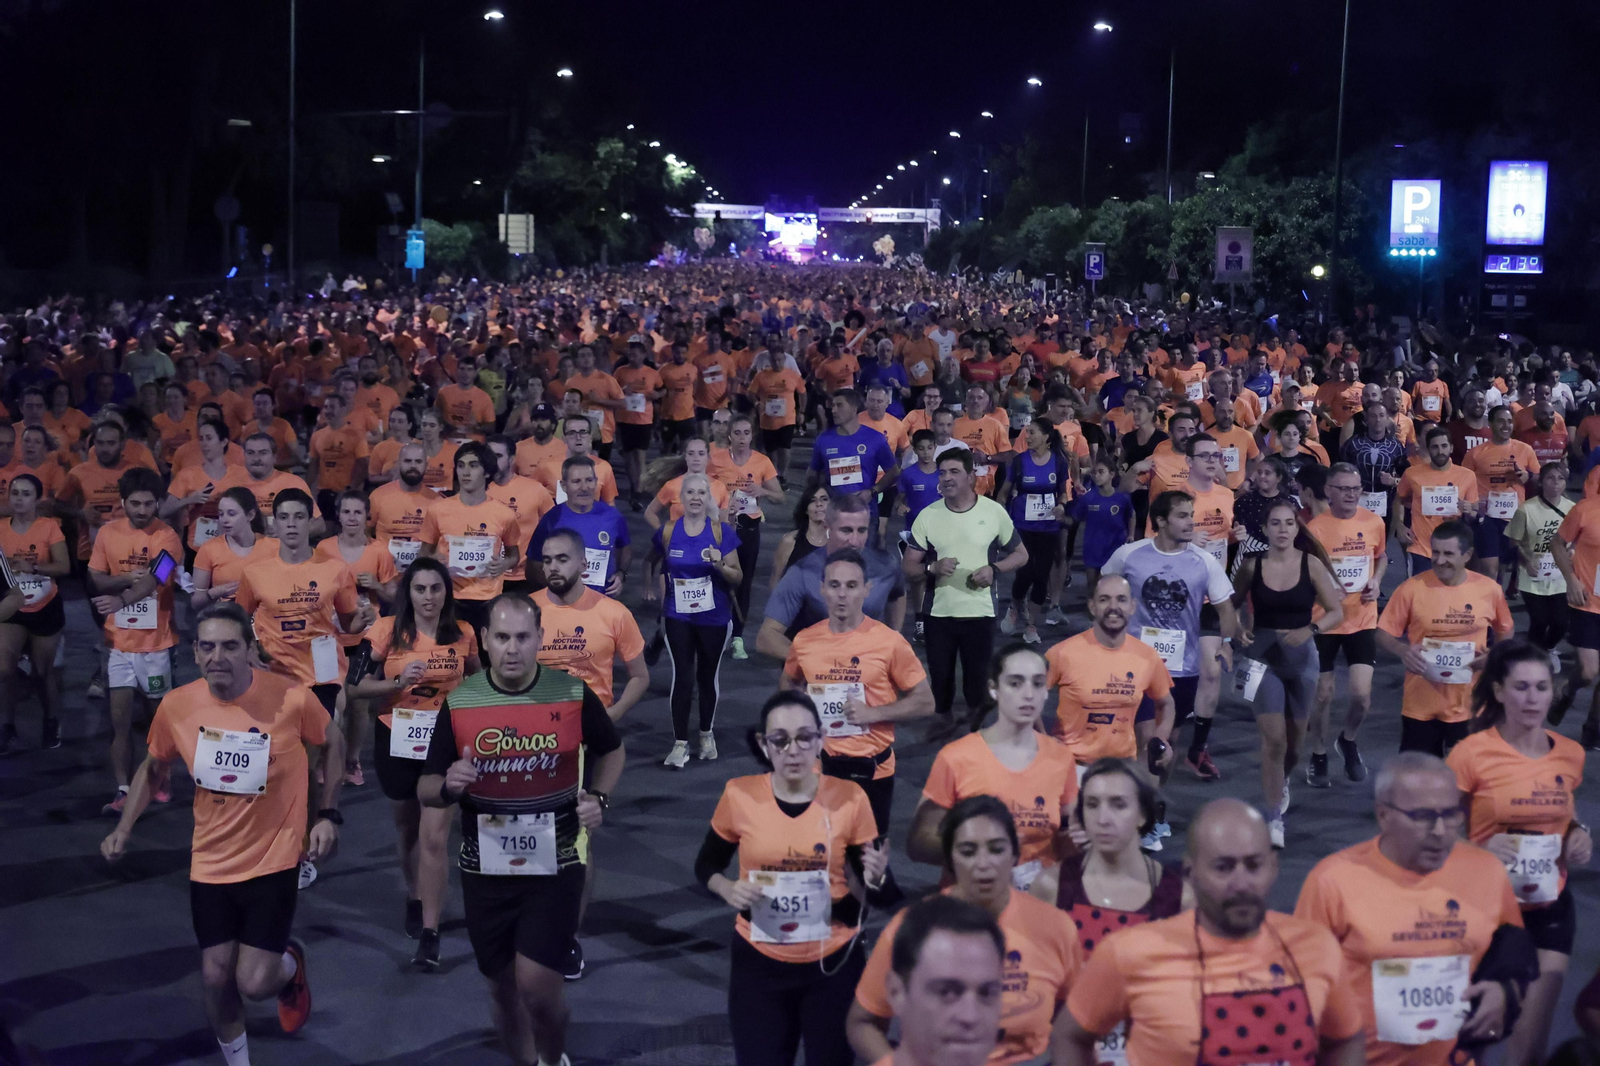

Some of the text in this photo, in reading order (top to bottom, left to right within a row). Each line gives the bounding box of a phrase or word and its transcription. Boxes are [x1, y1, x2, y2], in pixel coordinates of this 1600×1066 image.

[1404, 186, 1432, 224] P
[1415, 216, 1430, 224] 24h
[1398, 236, 1426, 246] saba
[1090, 255, 1100, 267] P
[1430, 496, 1452, 504] 13568
[1544, 520, 1559, 528] LAS
[1536, 528, 1558, 536] CHIC
[458, 552, 486, 562] 20939
[1211, 550, 1222, 560] 55
[587, 561, 600, 570] 418
[1336, 568, 1363, 578] 20557
[682, 588, 706, 600] 17384
[1154, 642, 1176, 654] 8905
[1435, 654, 1462, 667] 9028
[822, 702, 844, 714] 269
[476, 728, 558, 756] Gorras
[215, 750, 250, 768] 8709
[500, 836, 537, 850] 7150
[1510, 858, 1552, 874] 21906
[770, 896, 810, 912] 4351
[1398, 986, 1455, 1008] 10806
